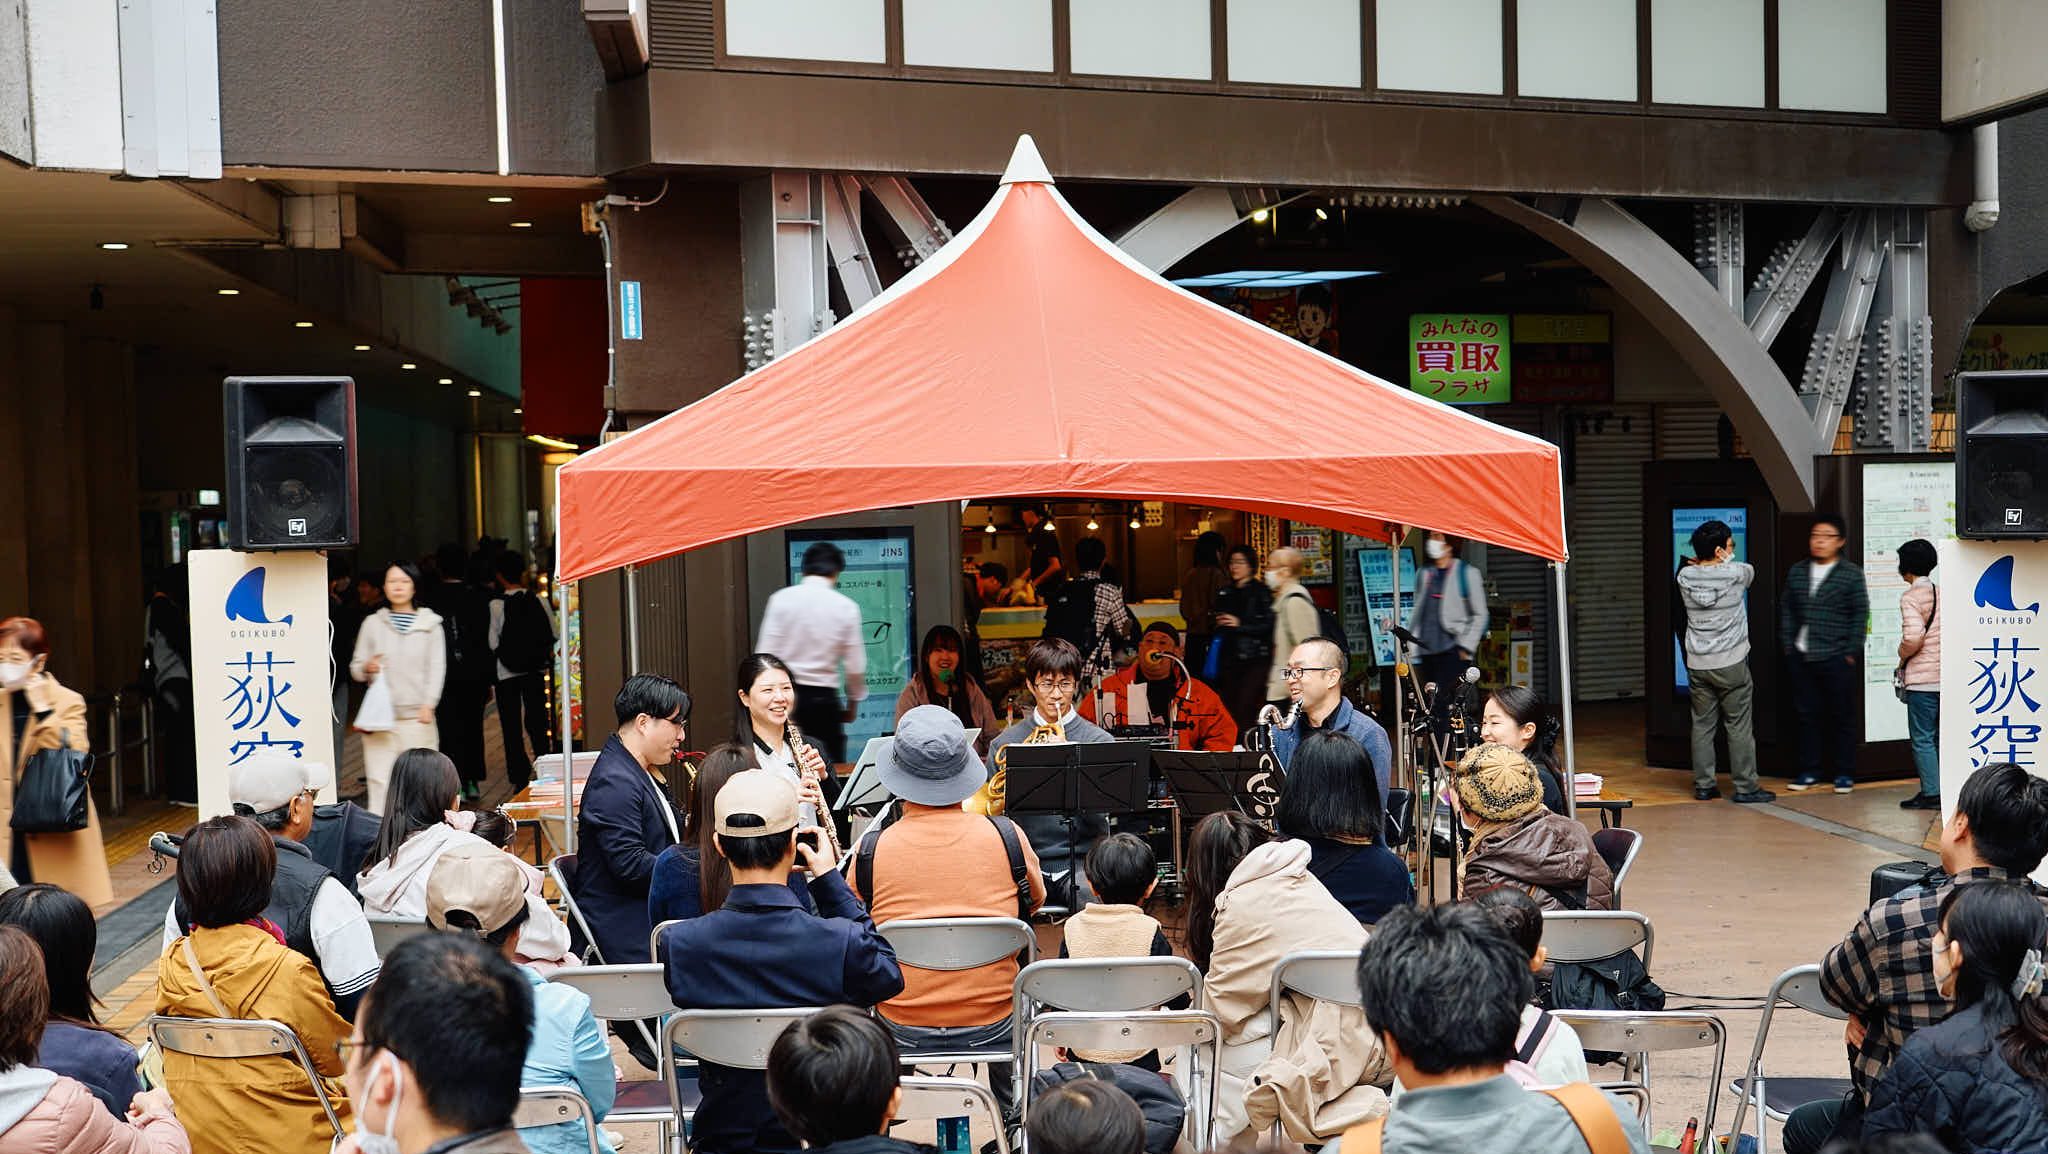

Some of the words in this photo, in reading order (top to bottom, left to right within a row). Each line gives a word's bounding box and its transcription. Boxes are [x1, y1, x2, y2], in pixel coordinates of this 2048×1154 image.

[1421, 318, 1498, 338] みんなの
[1416, 341, 1500, 373] 買取
[881, 547, 903, 557] JINS
[230, 629, 285, 638] OGIKUBO
